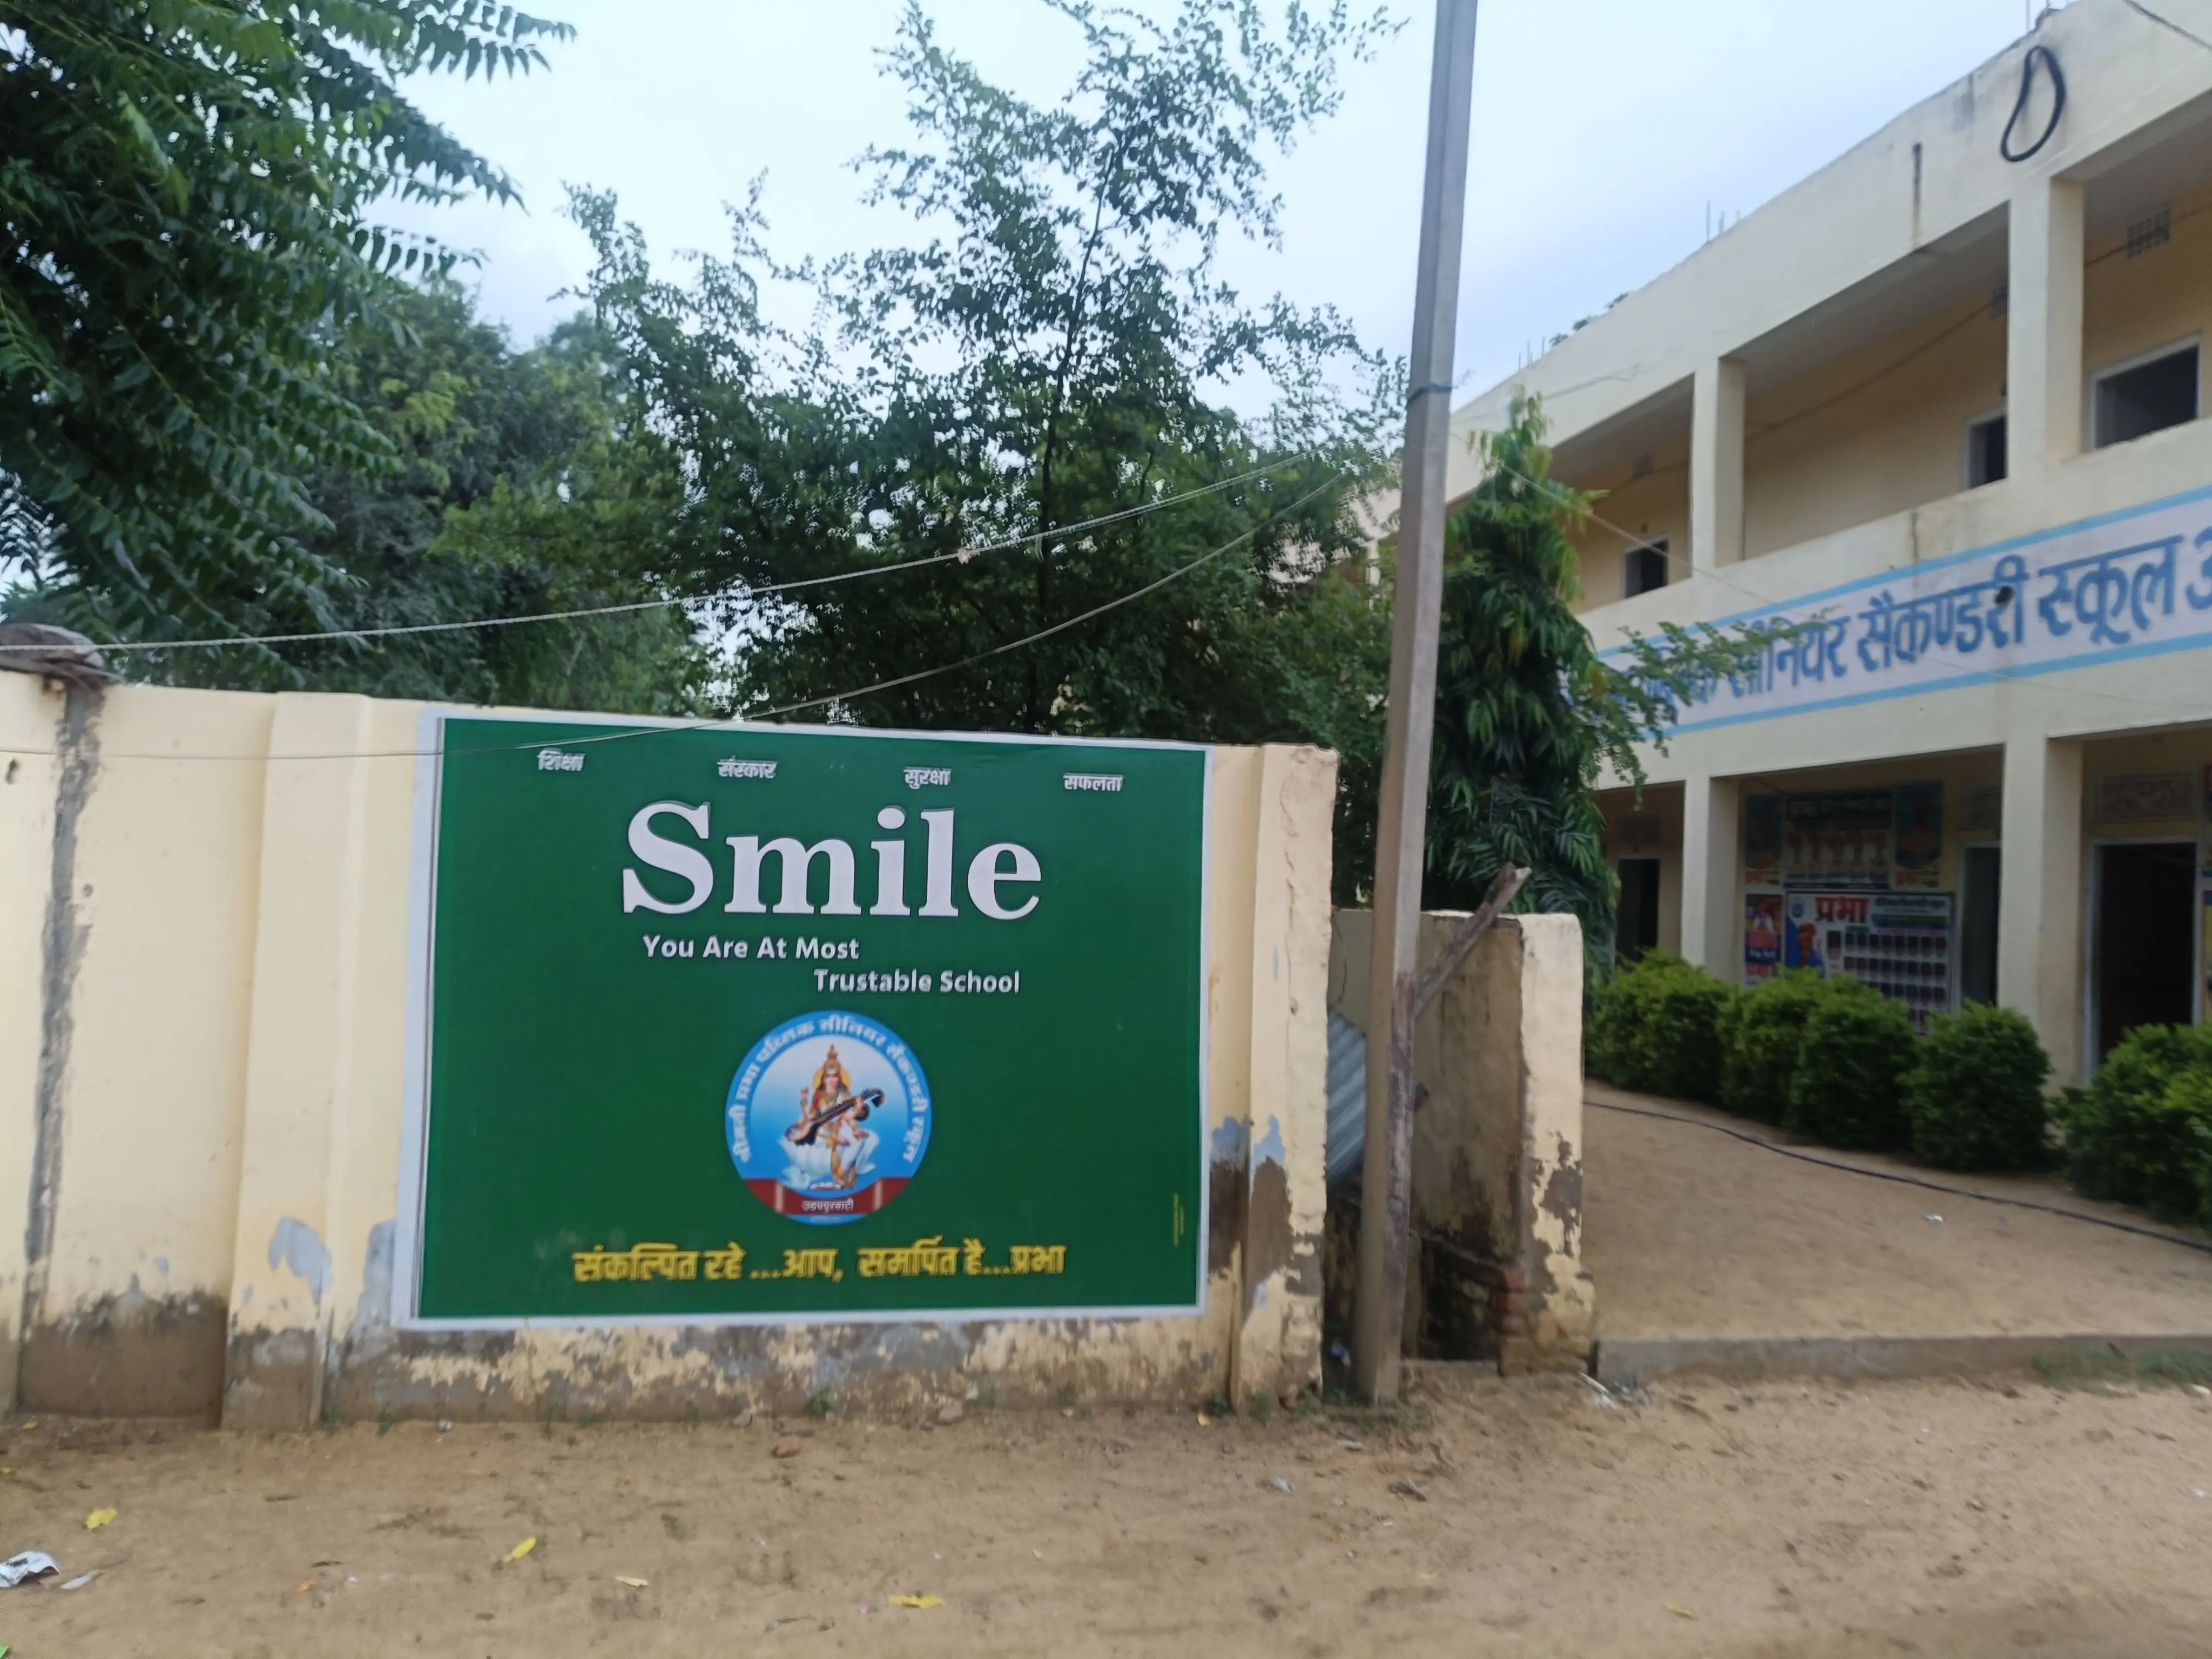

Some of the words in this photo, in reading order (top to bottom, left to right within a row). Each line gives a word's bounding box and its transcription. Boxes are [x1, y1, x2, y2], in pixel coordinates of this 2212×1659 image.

[1857, 554, 2030, 672] सैकण्डरी
[2038, 534, 2185, 645] स्कूल
[537, 747, 585, 772] शिक्षा
[717, 756, 778, 779] संस्कार
[903, 766, 953, 790] सुरक्षा
[1063, 772, 1124, 791] सफलता
[623, 800, 1041, 920] Smile
[643, 934, 694, 959] You
[703, 935, 748, 959] Are
[757, 936, 787, 960] At
[795, 936, 860, 960] Most
[813, 968, 932, 994] Trustable
[940, 969, 1020, 995] School
